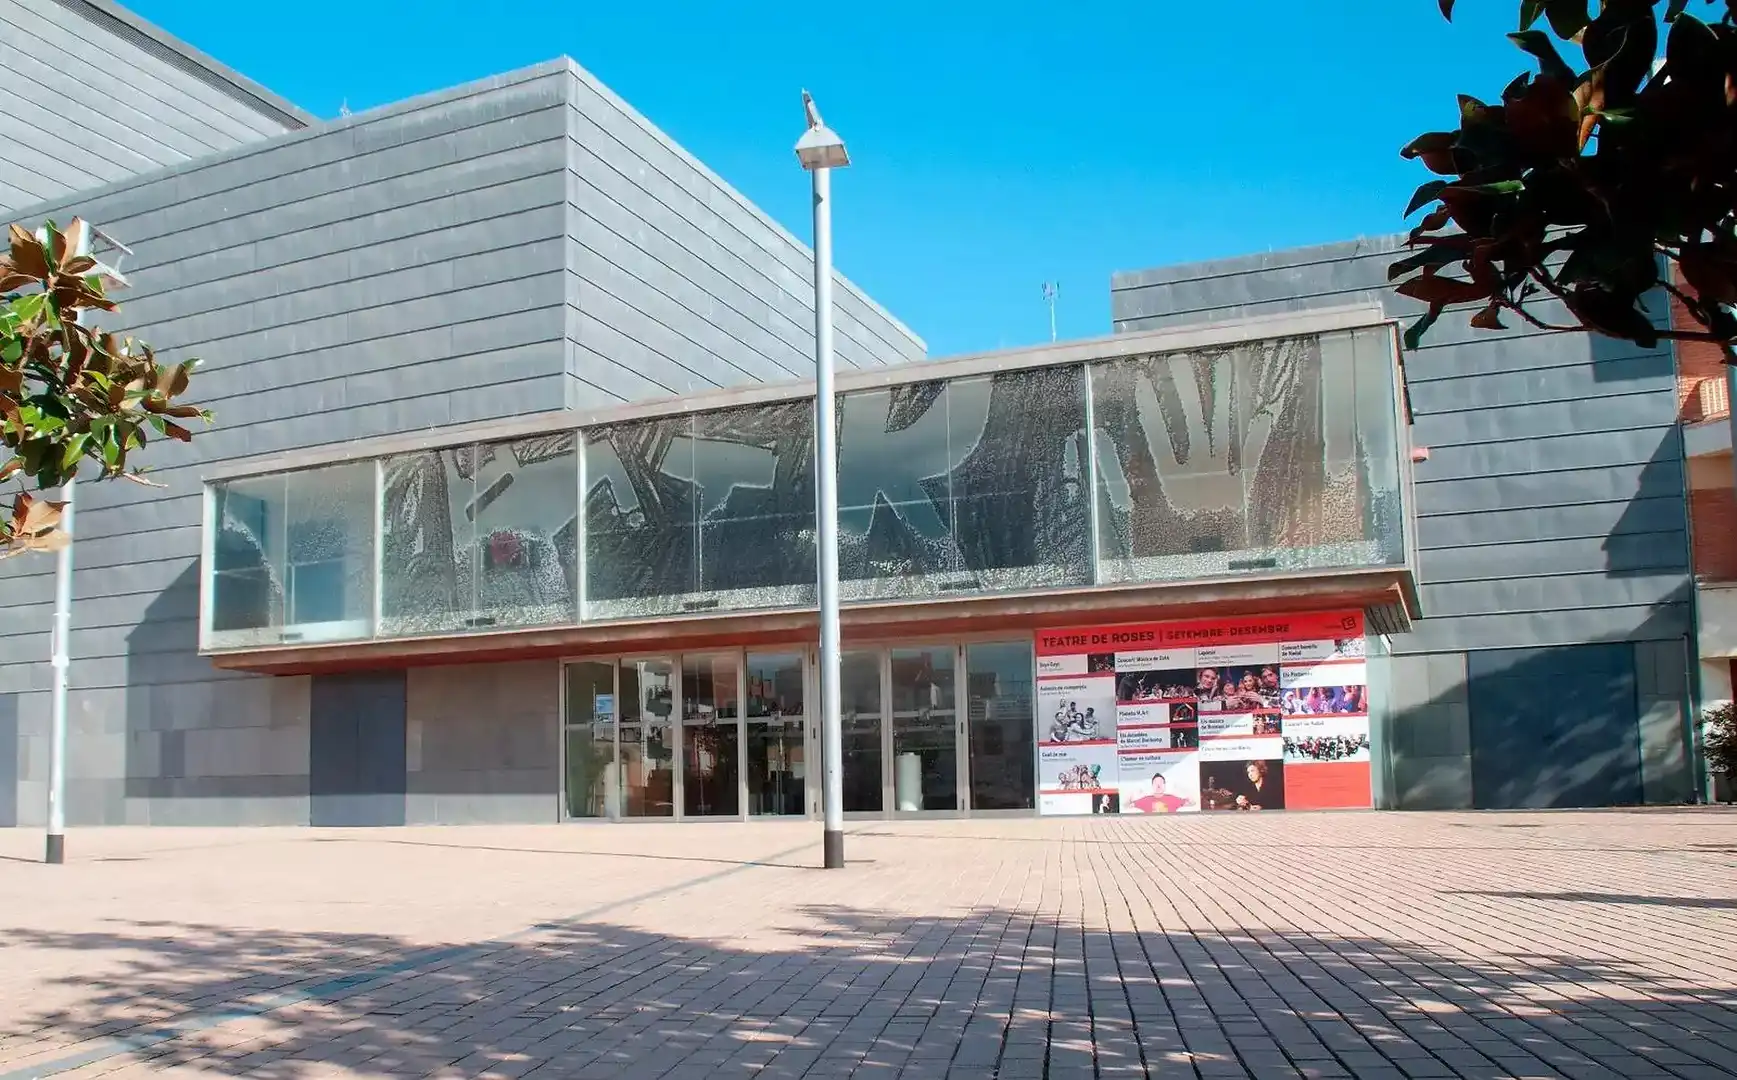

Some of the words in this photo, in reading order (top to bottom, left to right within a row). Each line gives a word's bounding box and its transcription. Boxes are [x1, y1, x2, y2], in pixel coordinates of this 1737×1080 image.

[1042, 634, 1087, 647] TEATRE
[1091, 633, 1109, 645] DE
[1112, 630, 1155, 643] ROSES
[1166, 628, 1223, 640] SETEMBRE
[1229, 623, 1290, 636] DESEMBRE
